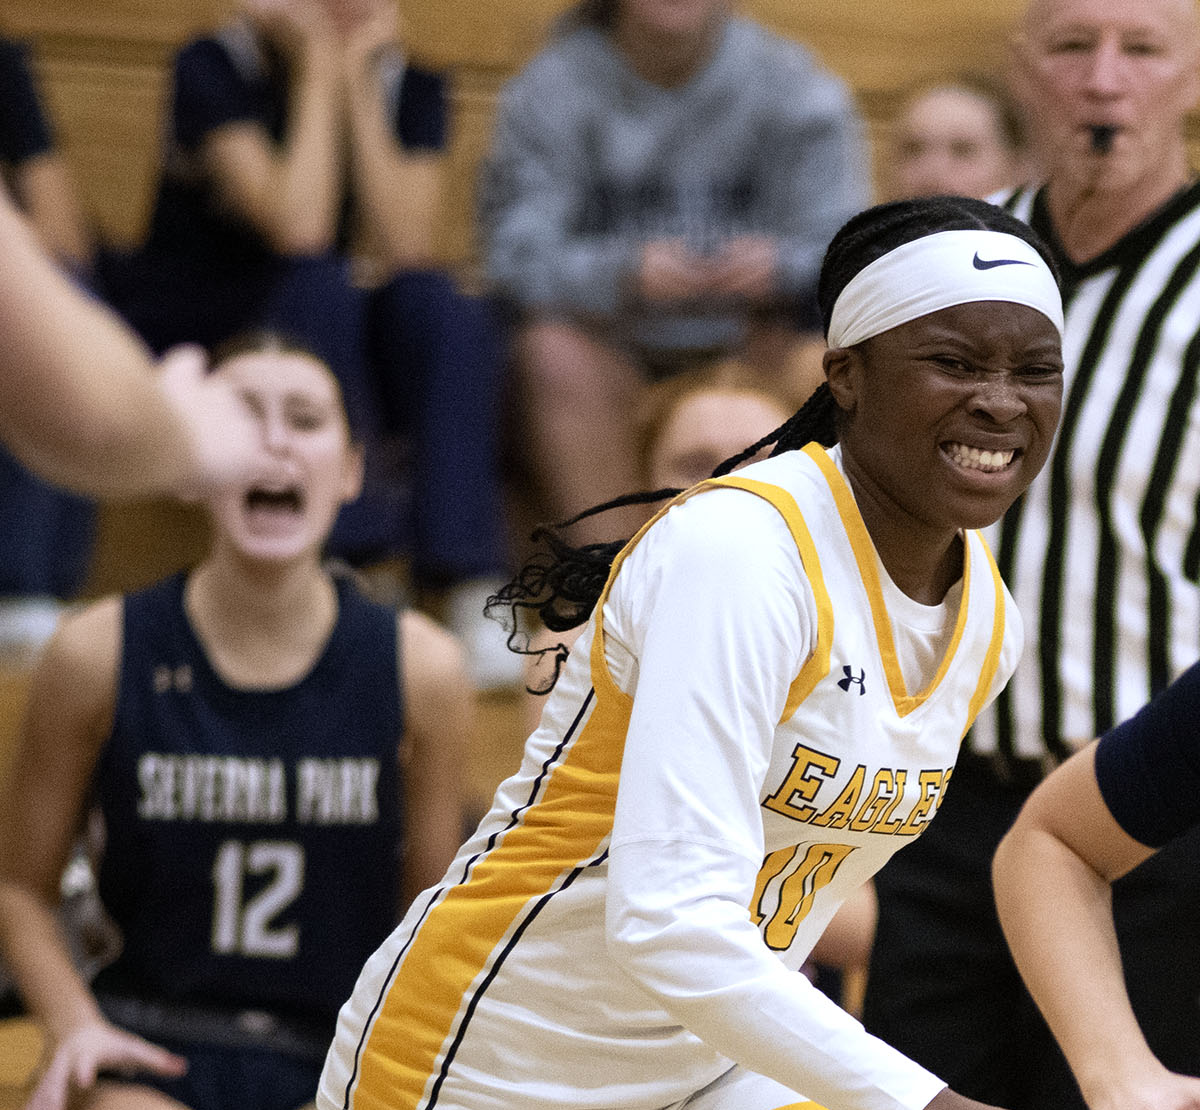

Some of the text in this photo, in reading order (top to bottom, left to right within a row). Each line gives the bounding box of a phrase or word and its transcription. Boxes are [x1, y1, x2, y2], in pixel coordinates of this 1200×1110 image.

[138, 754, 379, 825] SEVERNA PARK
[212, 840, 305, 957] 12
